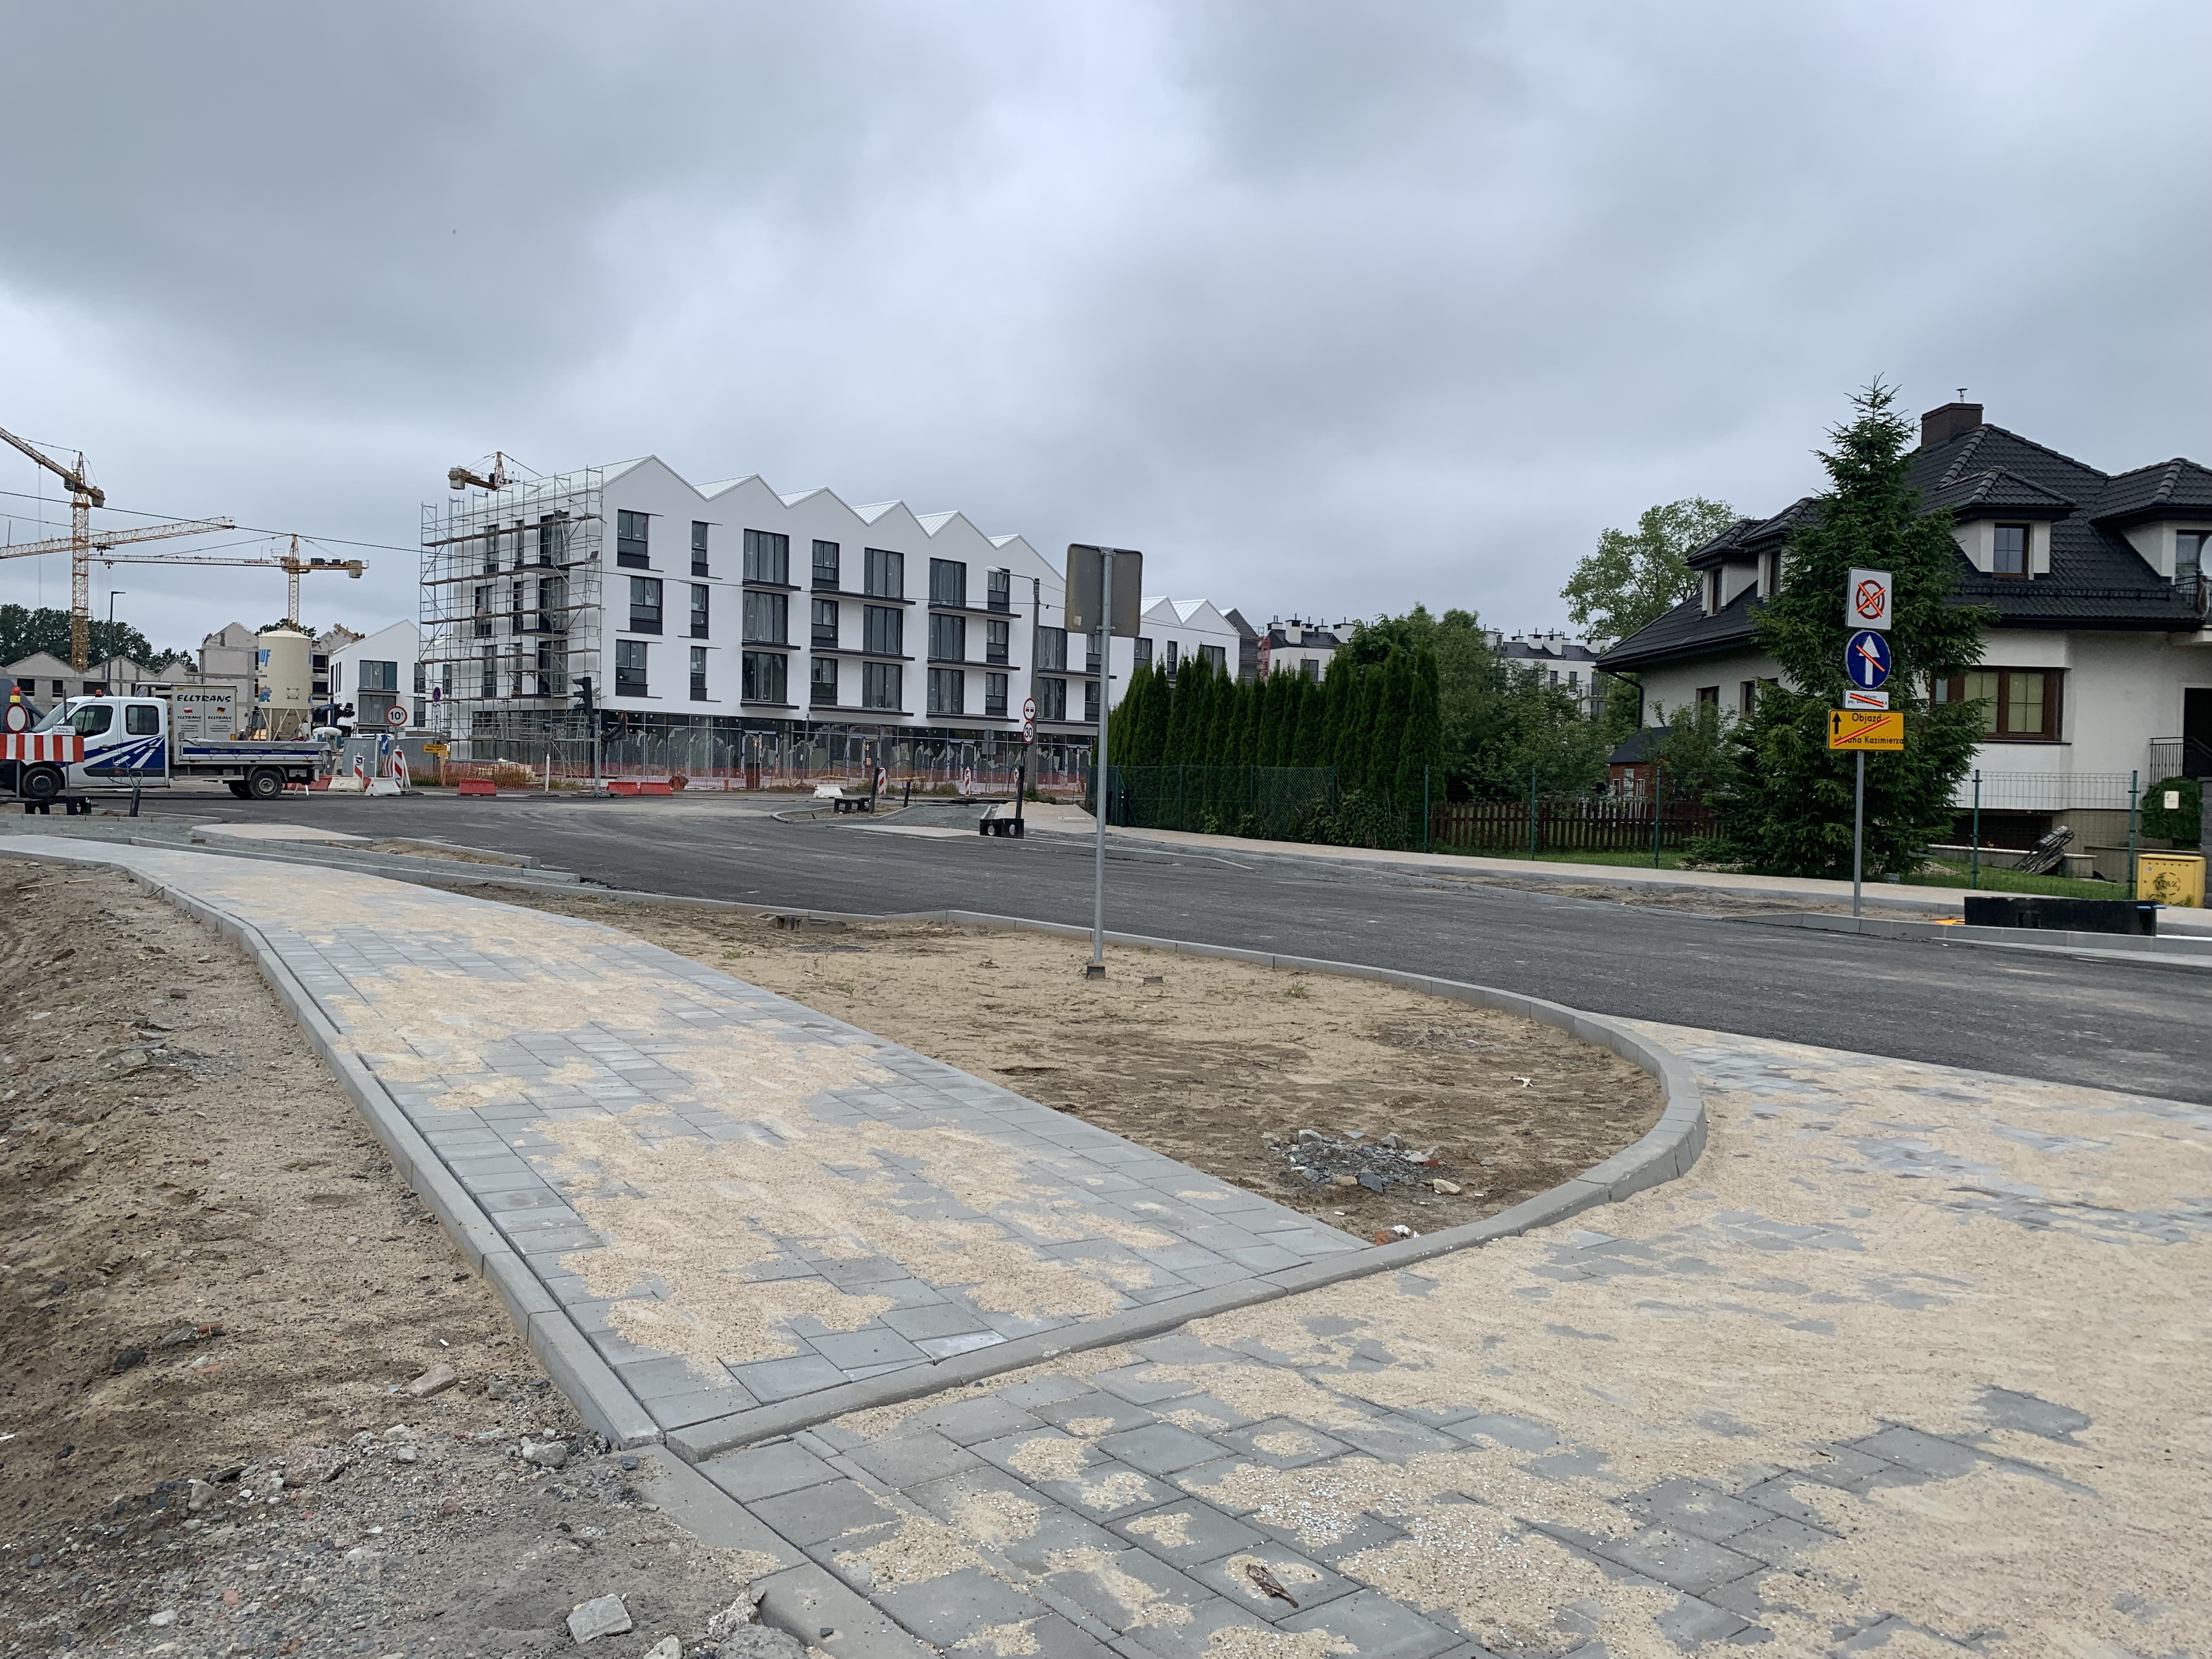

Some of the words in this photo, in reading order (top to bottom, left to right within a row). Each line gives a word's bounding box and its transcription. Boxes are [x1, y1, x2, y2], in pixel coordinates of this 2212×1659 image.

[1852, 713, 1882, 724] Objazd
[1025, 727, 1032, 738] 30
[1865, 736, 1904, 744] Kazimierza
